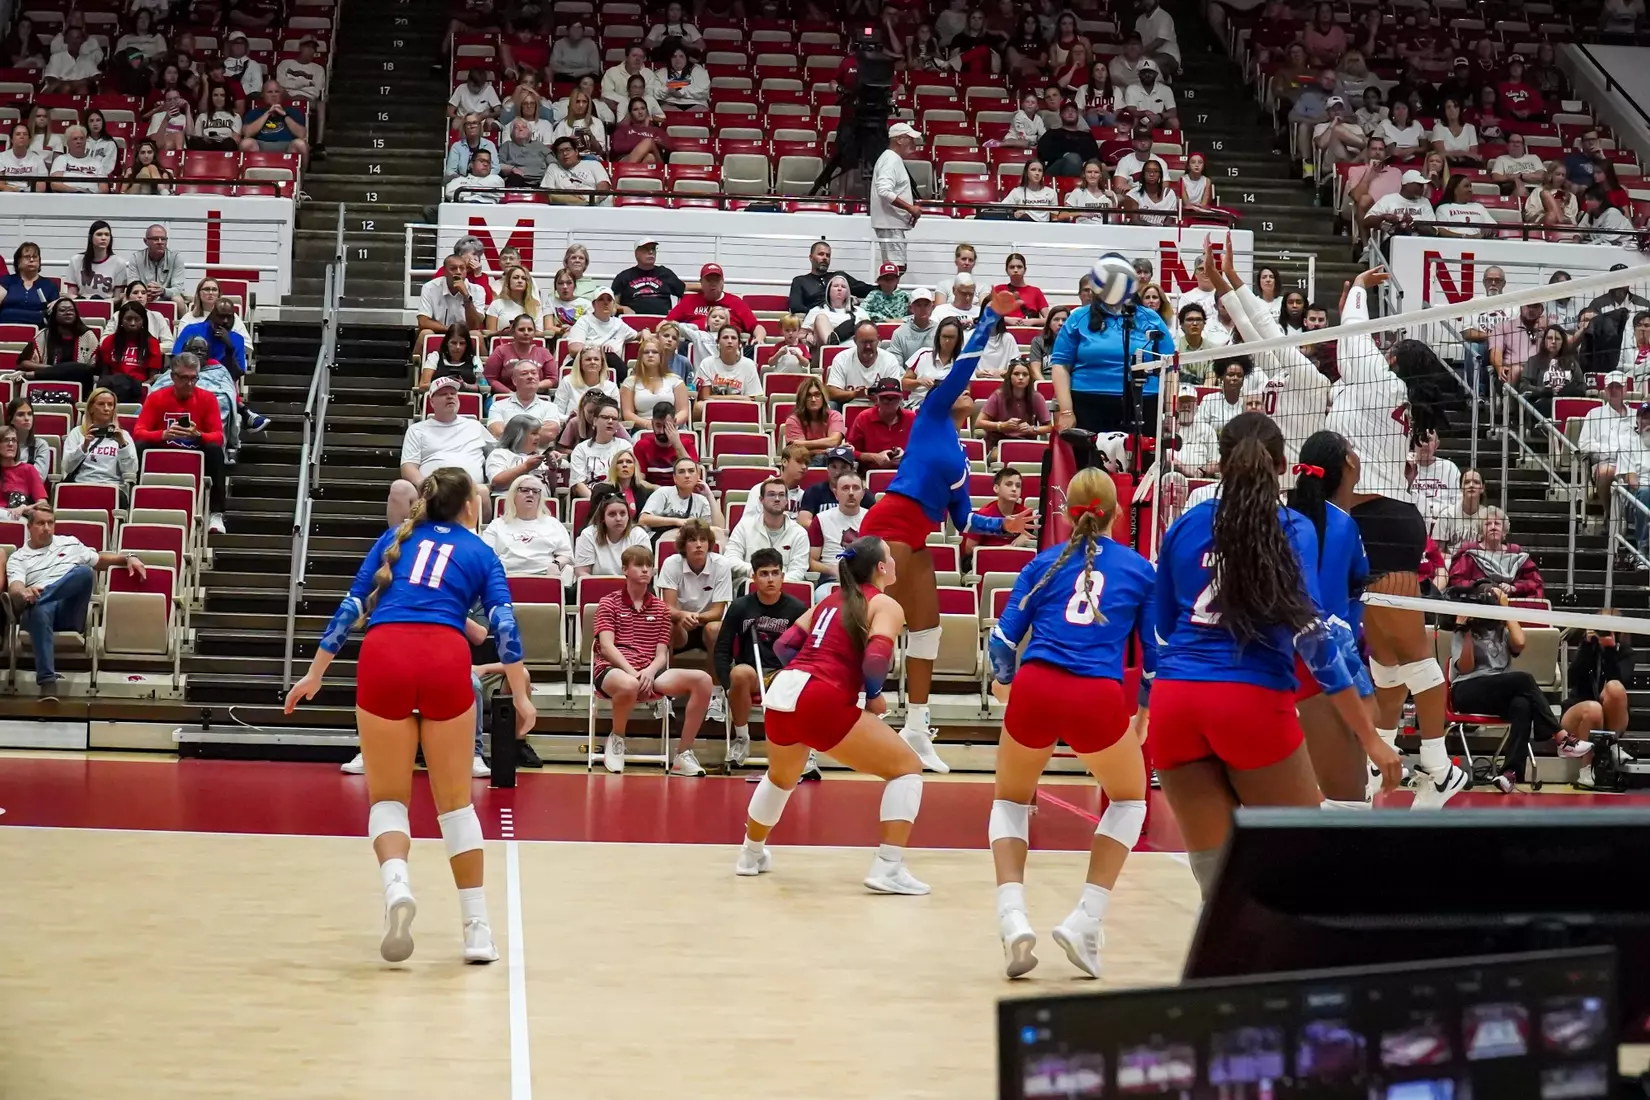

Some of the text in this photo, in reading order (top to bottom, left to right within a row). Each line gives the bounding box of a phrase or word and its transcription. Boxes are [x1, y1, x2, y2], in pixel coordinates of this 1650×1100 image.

[393, 40, 404, 48] 19
[383, 62, 394, 71] 18
[380, 86, 391, 95] 17
[1184, 90, 1195, 99] 18
[377, 112, 389, 121] 16
[1197, 114, 1208, 123] 17
[373, 139, 385, 148] 15
[1212, 140, 1223, 150] 16
[368, 164, 381, 174] 14
[1227, 167, 1239, 177] 15
[365, 192, 378, 202] 13
[1243, 193, 1255, 203] 14
[361, 220, 375, 230] 12
[1261, 221, 1273, 231] 13
[468, 216, 535, 280] M
[358, 248, 368, 259] 11
[81, 270, 113, 293] WPS
[1422, 250, 1475, 305] N
[1297, 279, 1306, 289] 11
[408, 539, 455, 589] 11
[1065, 570, 1105, 625] 8
[812, 607, 838, 649] 4
